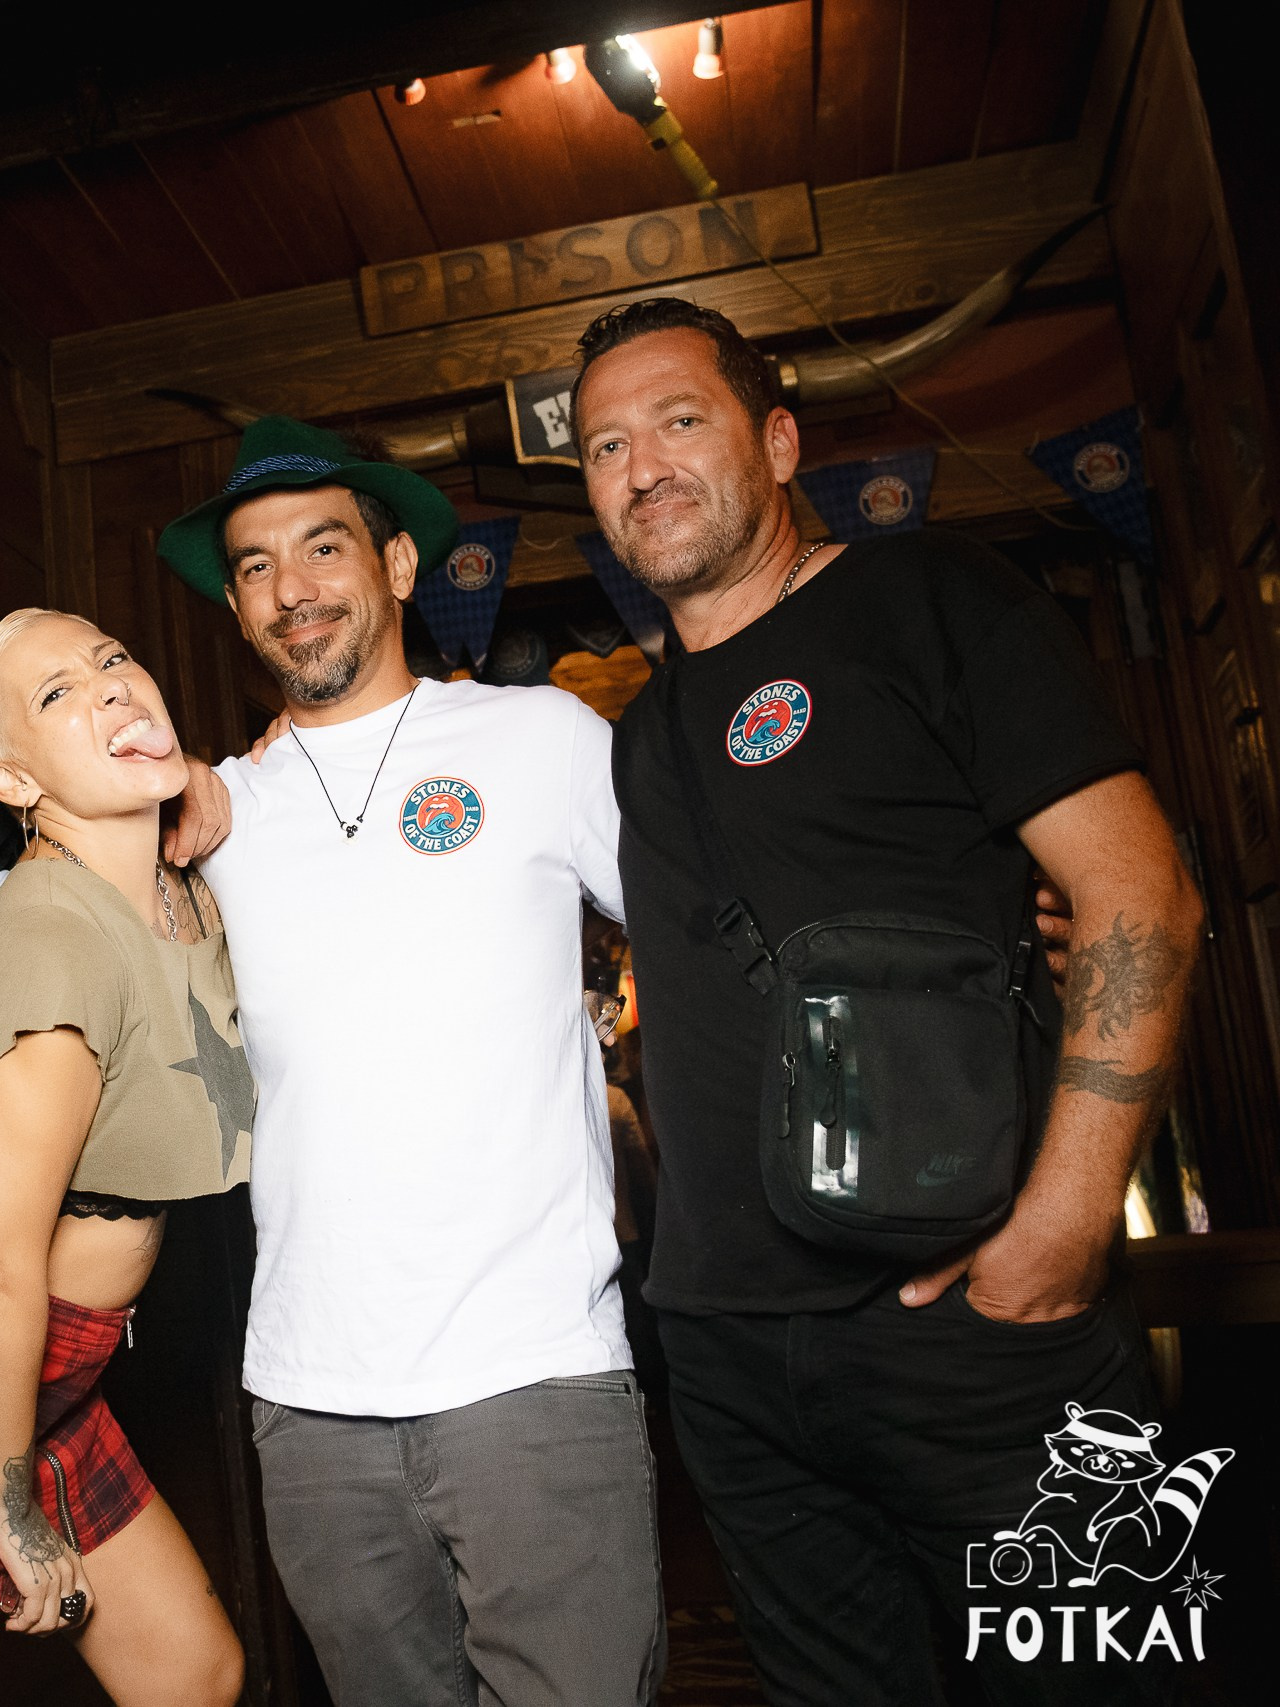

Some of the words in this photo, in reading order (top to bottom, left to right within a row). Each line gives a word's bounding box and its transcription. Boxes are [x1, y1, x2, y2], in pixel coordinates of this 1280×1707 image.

[375, 199, 761, 329] PRISON
[742, 684, 801, 716] STONES
[731, 735, 744, 751] OF
[738, 746, 763, 760] THE
[765, 719, 804, 758] COAST
[410, 780, 470, 806] STONES
[404, 823, 419, 839] OF
[415, 836, 442, 851] THE
[444, 815, 479, 848] COAST
